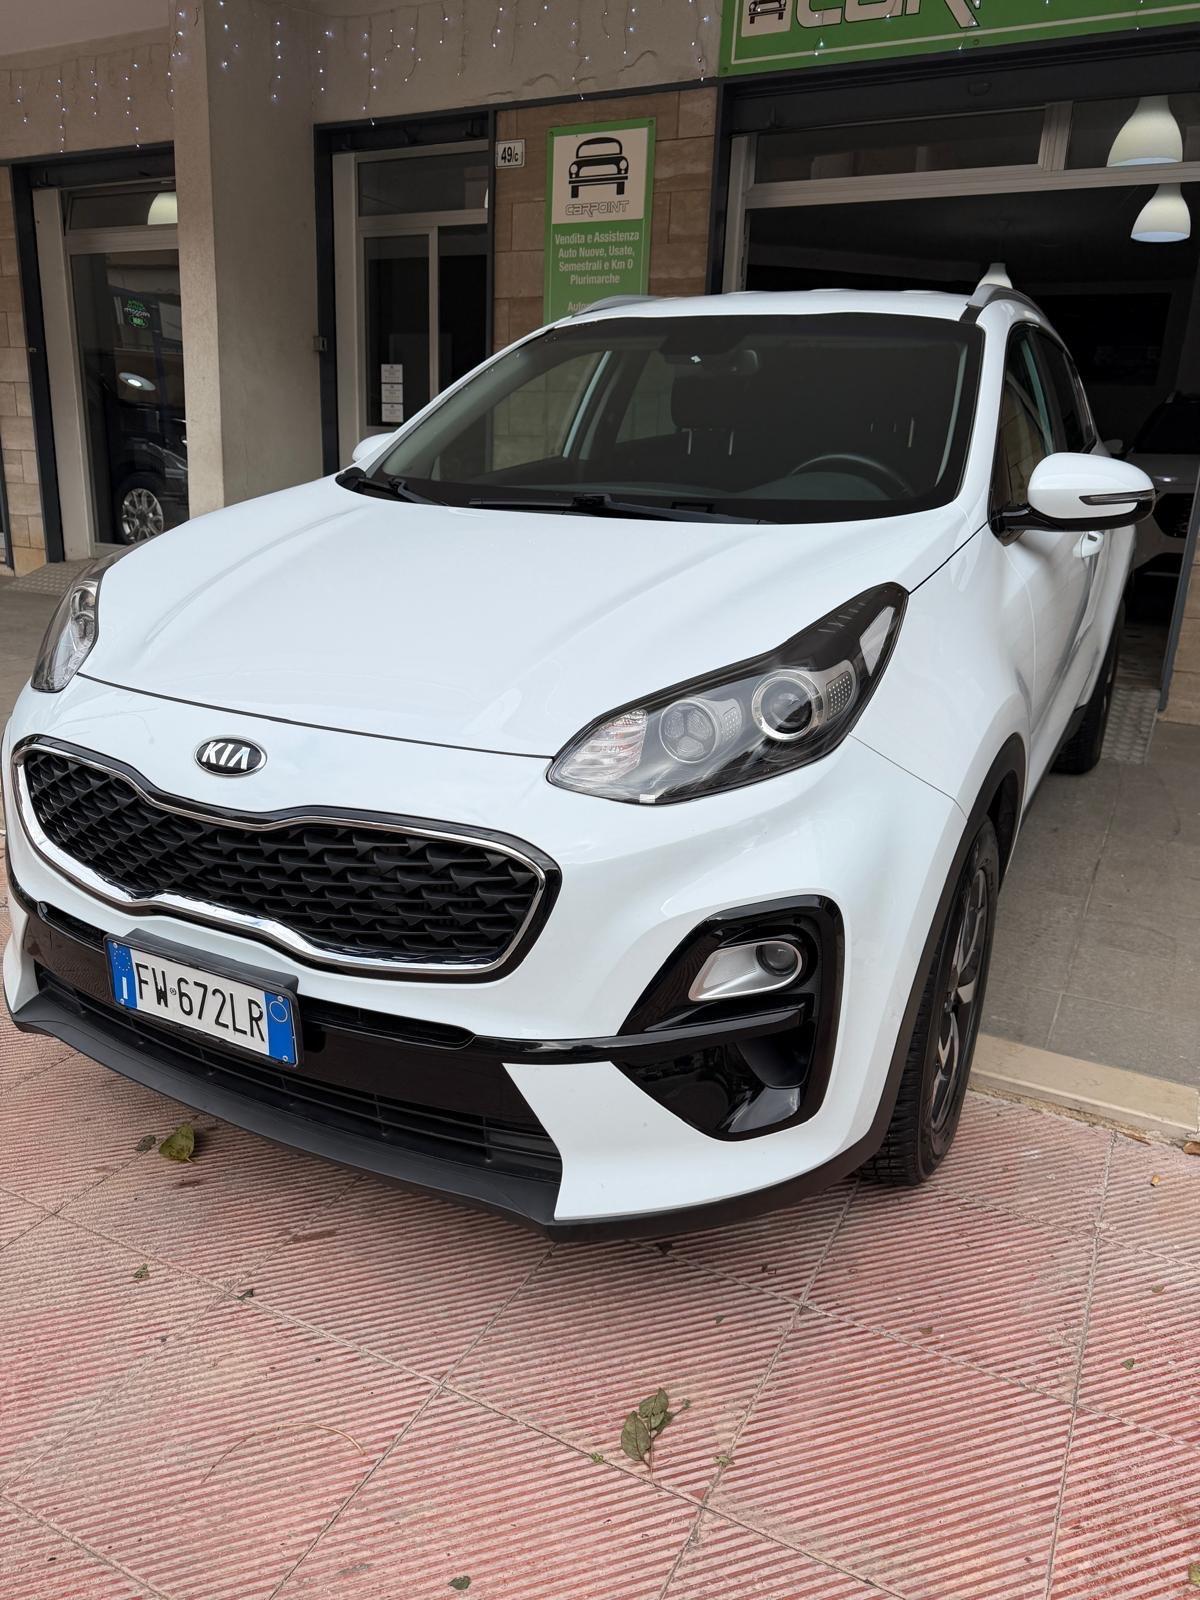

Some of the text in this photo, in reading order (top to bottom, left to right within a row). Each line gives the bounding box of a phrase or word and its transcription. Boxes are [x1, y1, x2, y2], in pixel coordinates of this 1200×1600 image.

[555, 230, 640, 245] Vendita e Assistenza
[558, 248, 577, 258] Auto
[608, 245, 635, 257] Usate,
[559, 260, 602, 272] Semestrali
[604, 262, 609, 270] e
[611, 259, 626, 270] Km
[570, 273, 621, 285] Plurimarche
[201, 741, 251, 770] KIA
